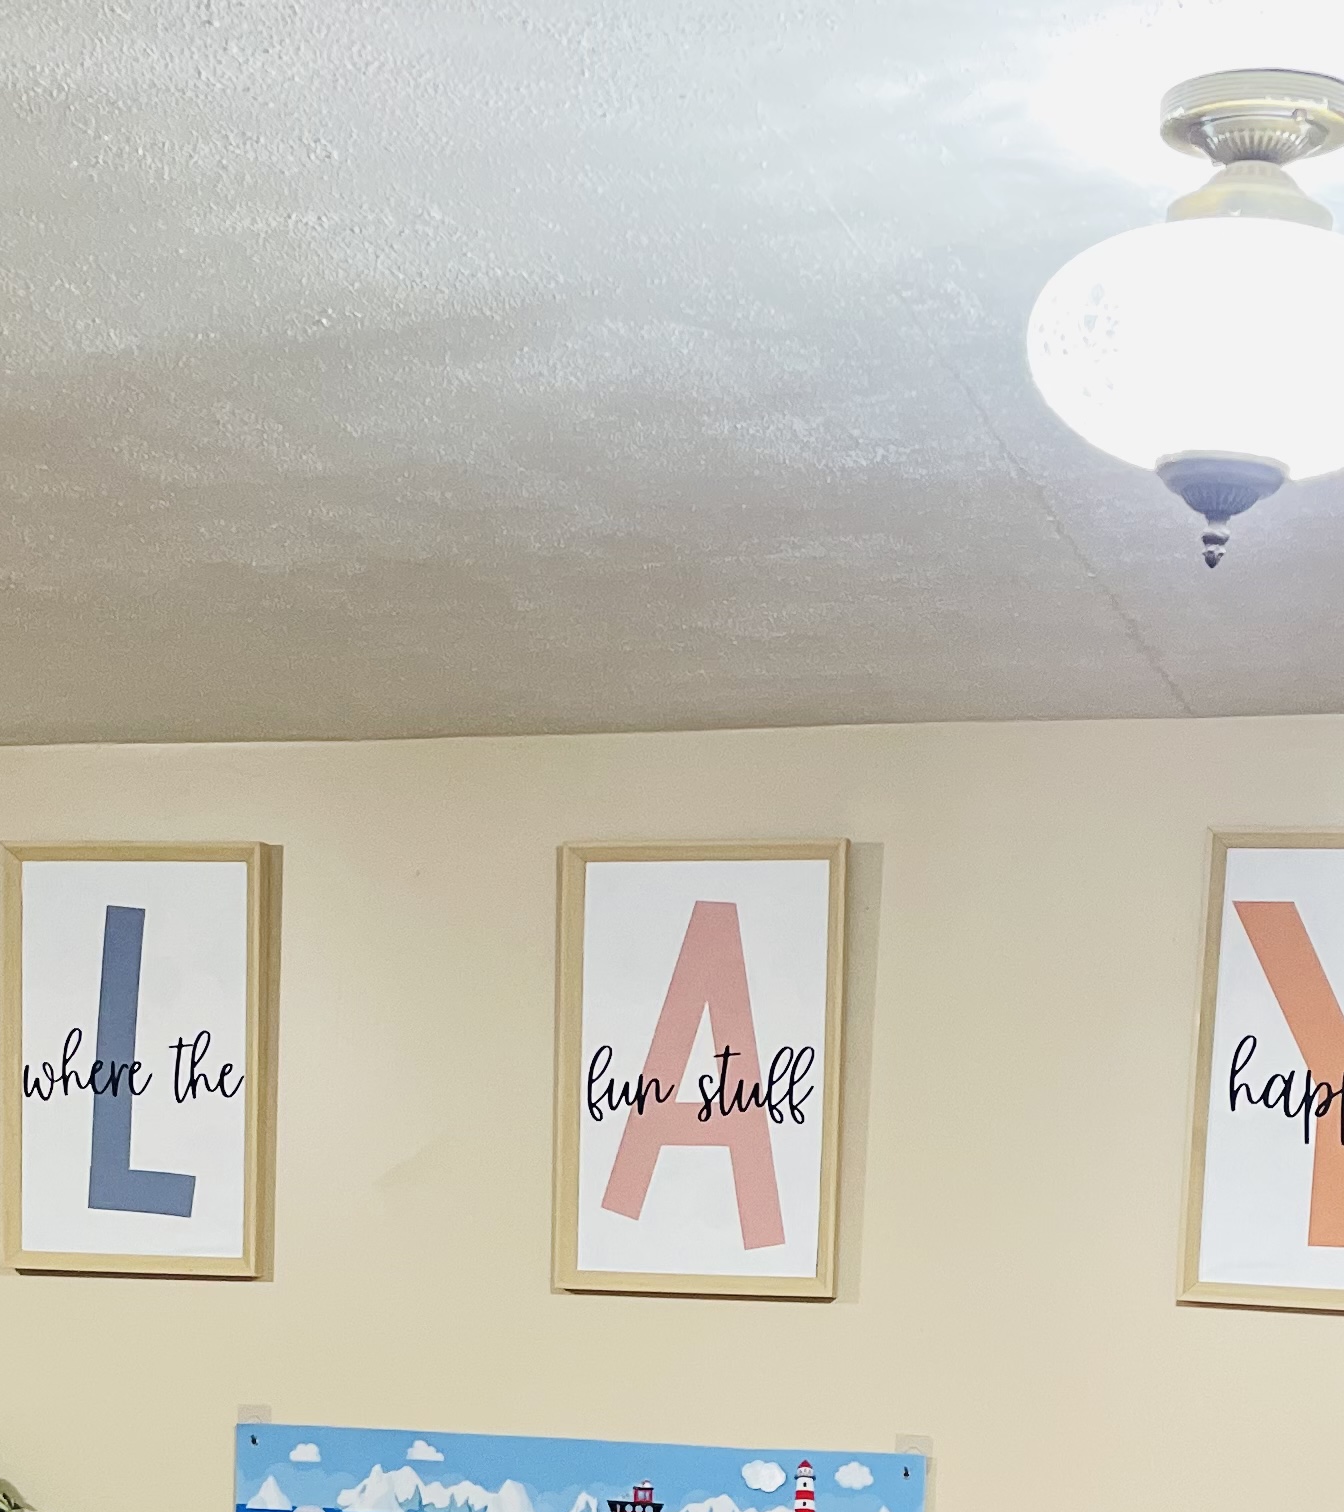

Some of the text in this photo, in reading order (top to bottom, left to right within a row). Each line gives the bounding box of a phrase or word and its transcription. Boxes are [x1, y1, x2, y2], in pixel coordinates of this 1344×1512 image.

[23, 1027, 245, 1103] where the
[88, 905, 196, 1218] L
[587, 1044, 815, 1125] fun stuff
[600, 900, 787, 1250] A
